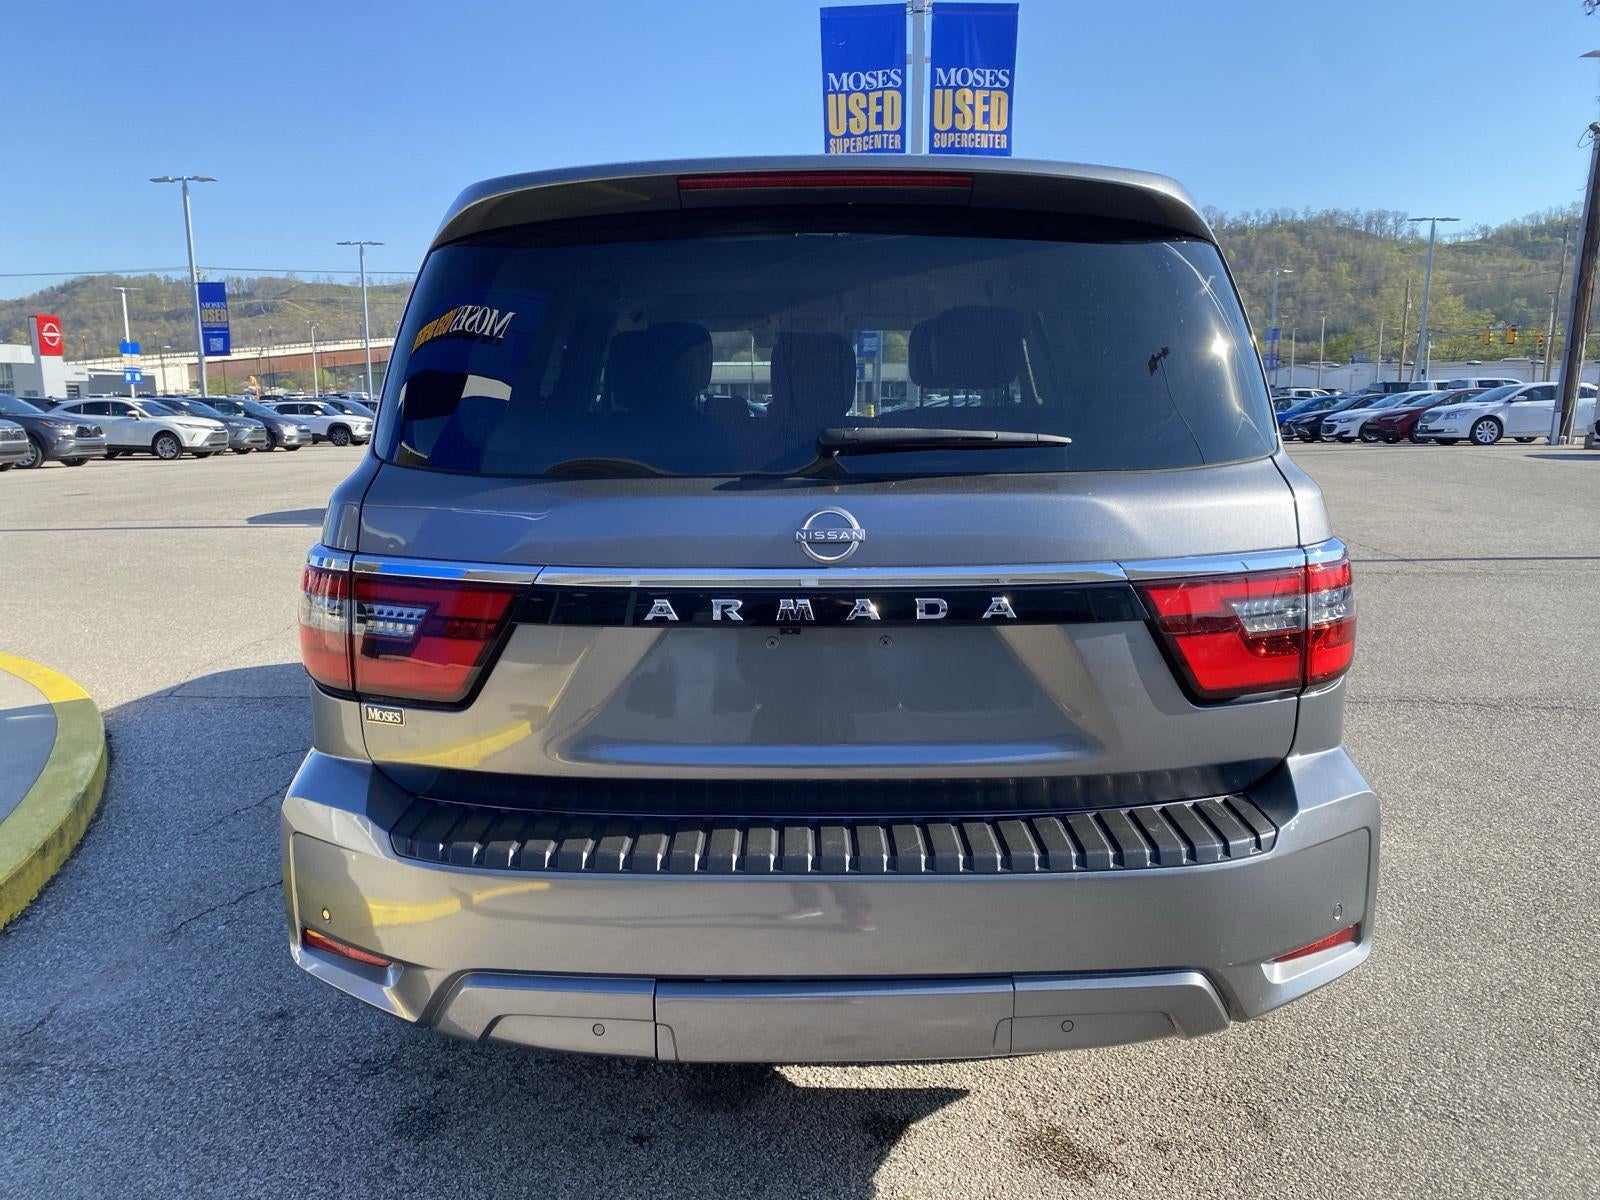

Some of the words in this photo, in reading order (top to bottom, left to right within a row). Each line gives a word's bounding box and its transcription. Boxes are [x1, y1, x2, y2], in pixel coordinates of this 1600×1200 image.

[827, 69, 903, 92] MOSES
[935, 67, 1010, 88] MOSES
[827, 90, 902, 136] USED
[933, 88, 1009, 131] USED
[829, 134, 901, 154] SUPERCENTER
[933, 133, 1007, 149] SUPERCENTER
[796, 531, 863, 540] NISSAN
[644, 596, 1018, 622] ARMADA
